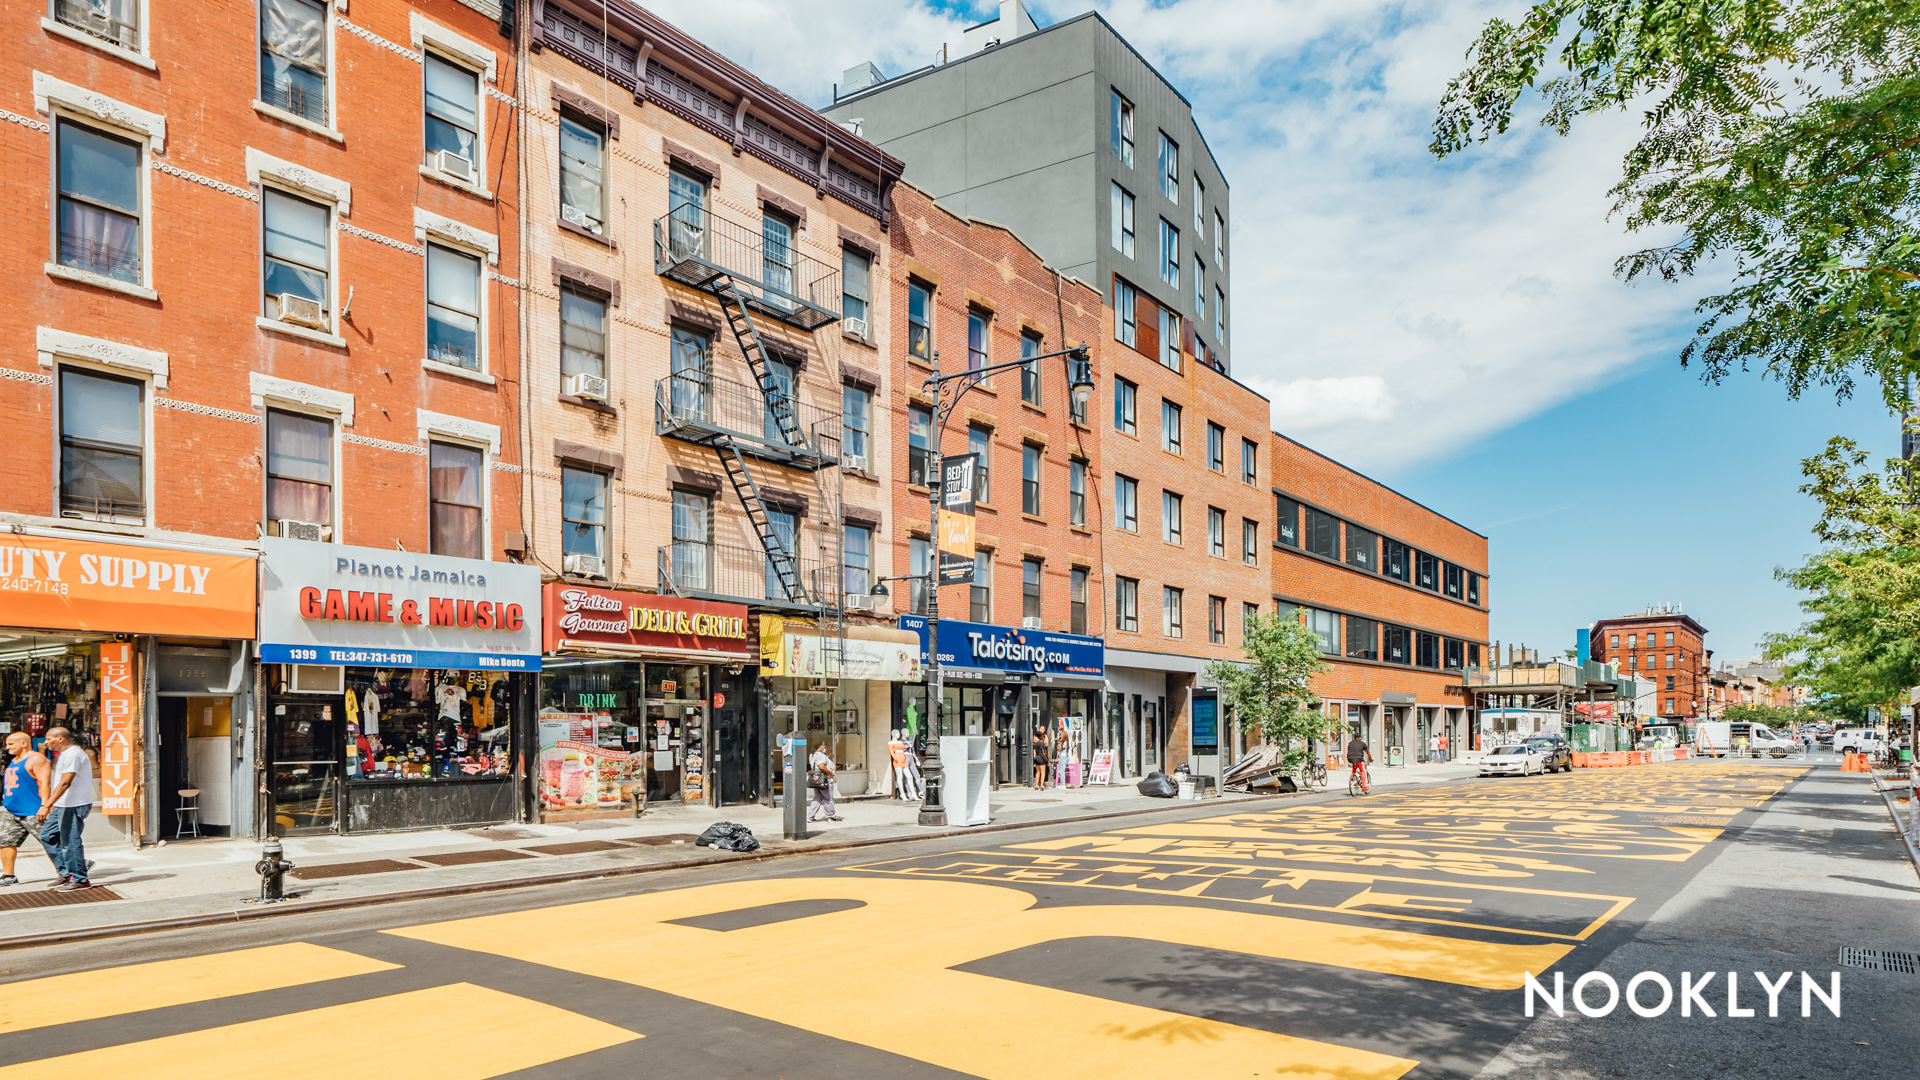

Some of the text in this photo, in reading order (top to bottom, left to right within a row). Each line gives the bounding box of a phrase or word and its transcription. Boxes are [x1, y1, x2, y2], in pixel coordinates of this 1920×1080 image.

[946, 480, 961, 493] STUY
[1282, 525, 1294, 538] blink
[80, 553, 211, 595] SUPPLY
[336, 557, 487, 586] Planet Jamaica
[561, 589, 622, 612] Fulton
[299, 586, 524, 632] GAME & MUSIC
[559, 613, 627, 634] Gourmet
[906, 619, 923, 629] 1407
[289, 649, 317, 660] 1399
[330, 651, 412, 664] TEL:347-731-6170
[479, 656, 500, 666] Mike
[663, 682, 675, 692] EXIT
[579, 693, 617, 708] DRINK
[105, 699, 129, 795] BEAUTY
[594, 748, 627, 758] DELICIOUS
[102, 797, 132, 809] SUPPLY
